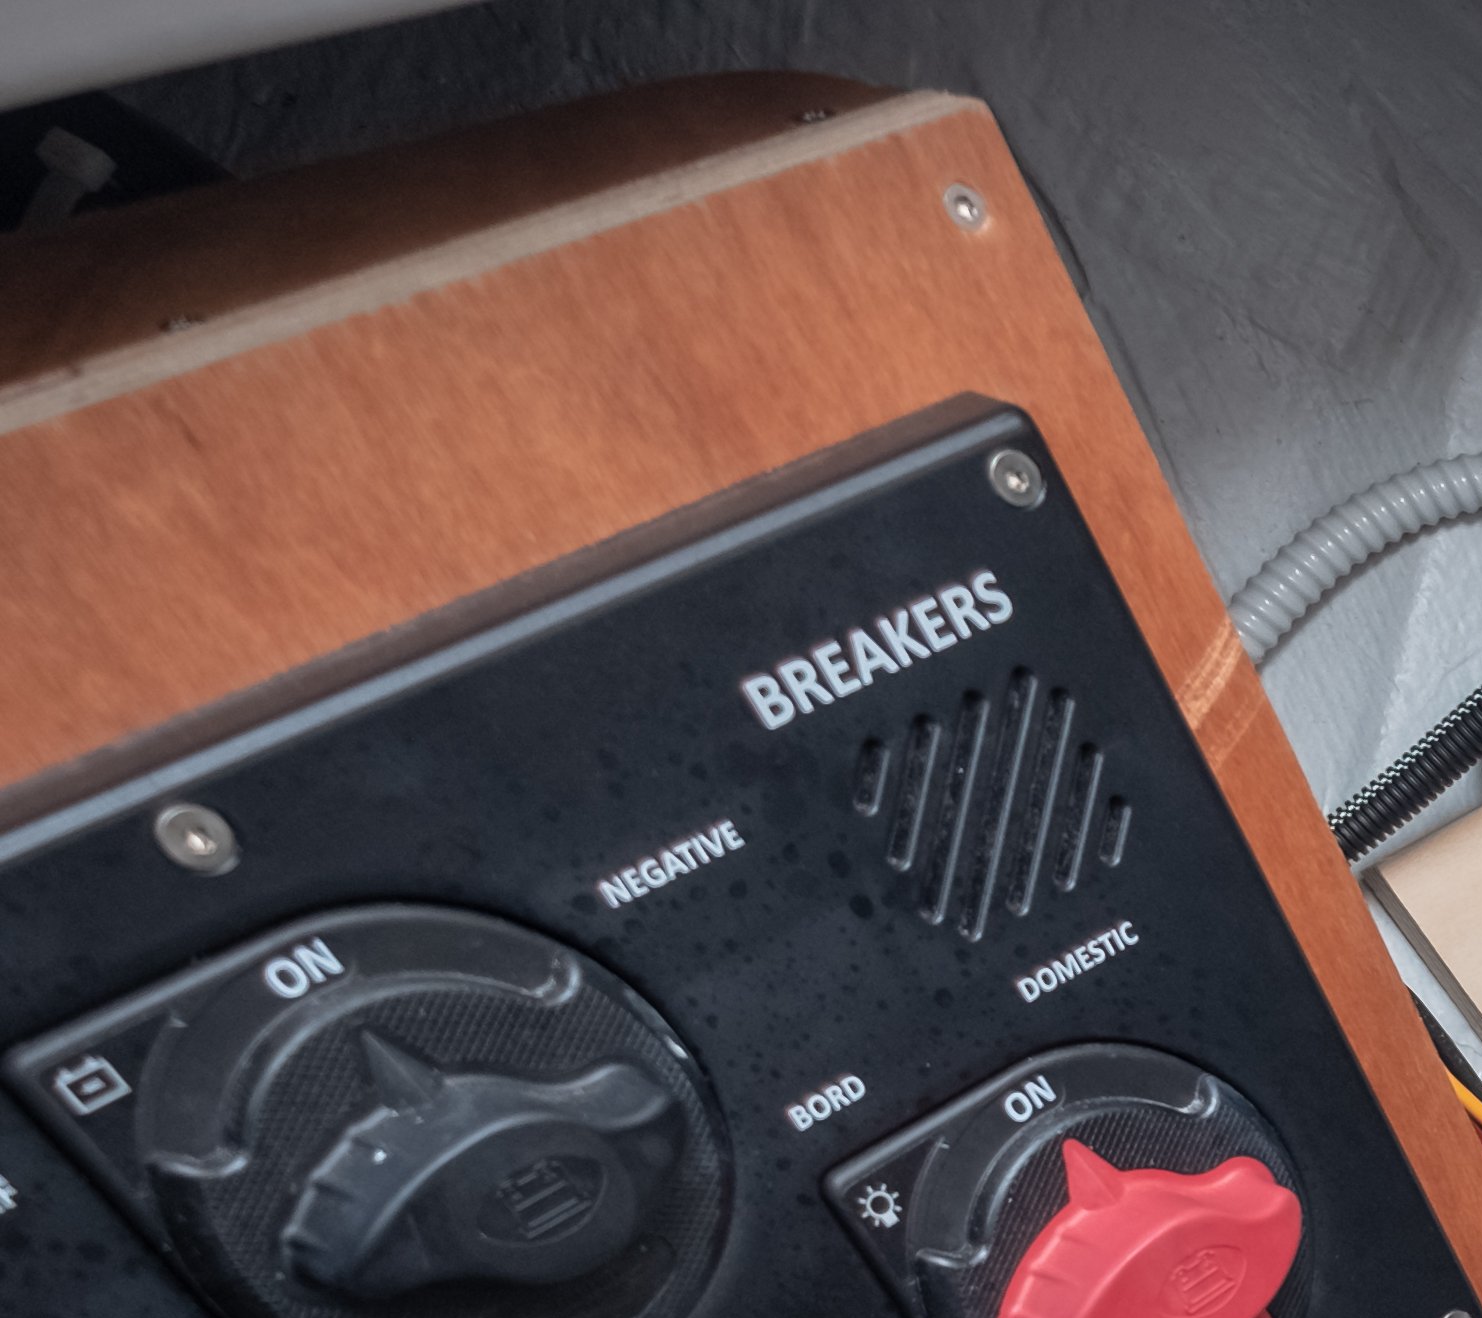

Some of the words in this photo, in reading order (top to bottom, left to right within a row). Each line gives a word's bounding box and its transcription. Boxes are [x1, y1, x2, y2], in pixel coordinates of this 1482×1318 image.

[739, 566, 1017, 734] BREAKERS
[596, 817, 746, 911] NEGATIVE
[266, 938, 344, 999] ON
[1015, 919, 1140, 1004] DOMESTIC
[789, 1072, 866, 1133] BORD
[1003, 1073, 1059, 1125] ON
